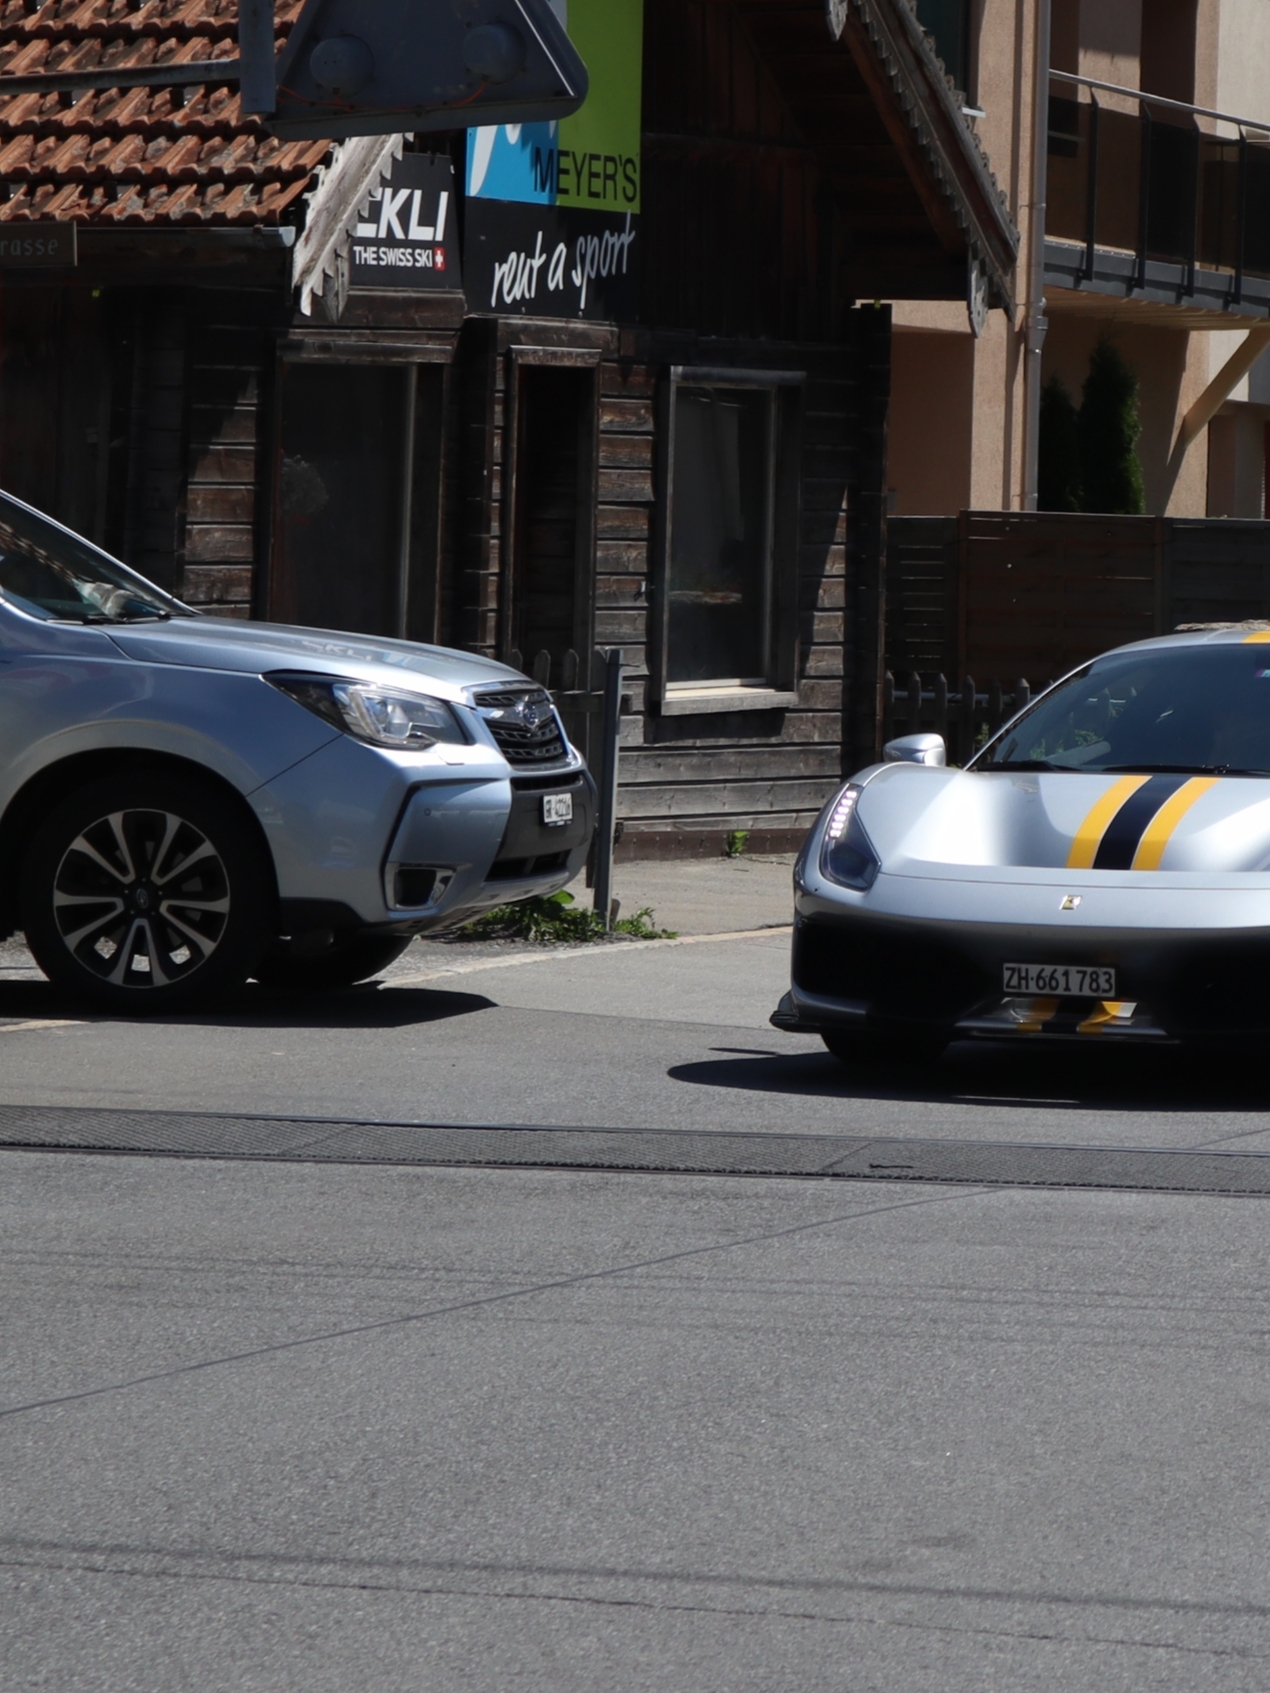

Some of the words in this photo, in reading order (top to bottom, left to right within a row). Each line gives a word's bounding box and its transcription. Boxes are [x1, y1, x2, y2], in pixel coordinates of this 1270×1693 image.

[534, 147, 638, 203] MEYER'S
[353, 246, 378, 265] THE
[379, 247, 414, 267] SWISS
[414, 248, 433, 267] SKI
[491, 231, 547, 307] rent
[548, 242, 567, 291] a
[572, 209, 635, 310] sport
